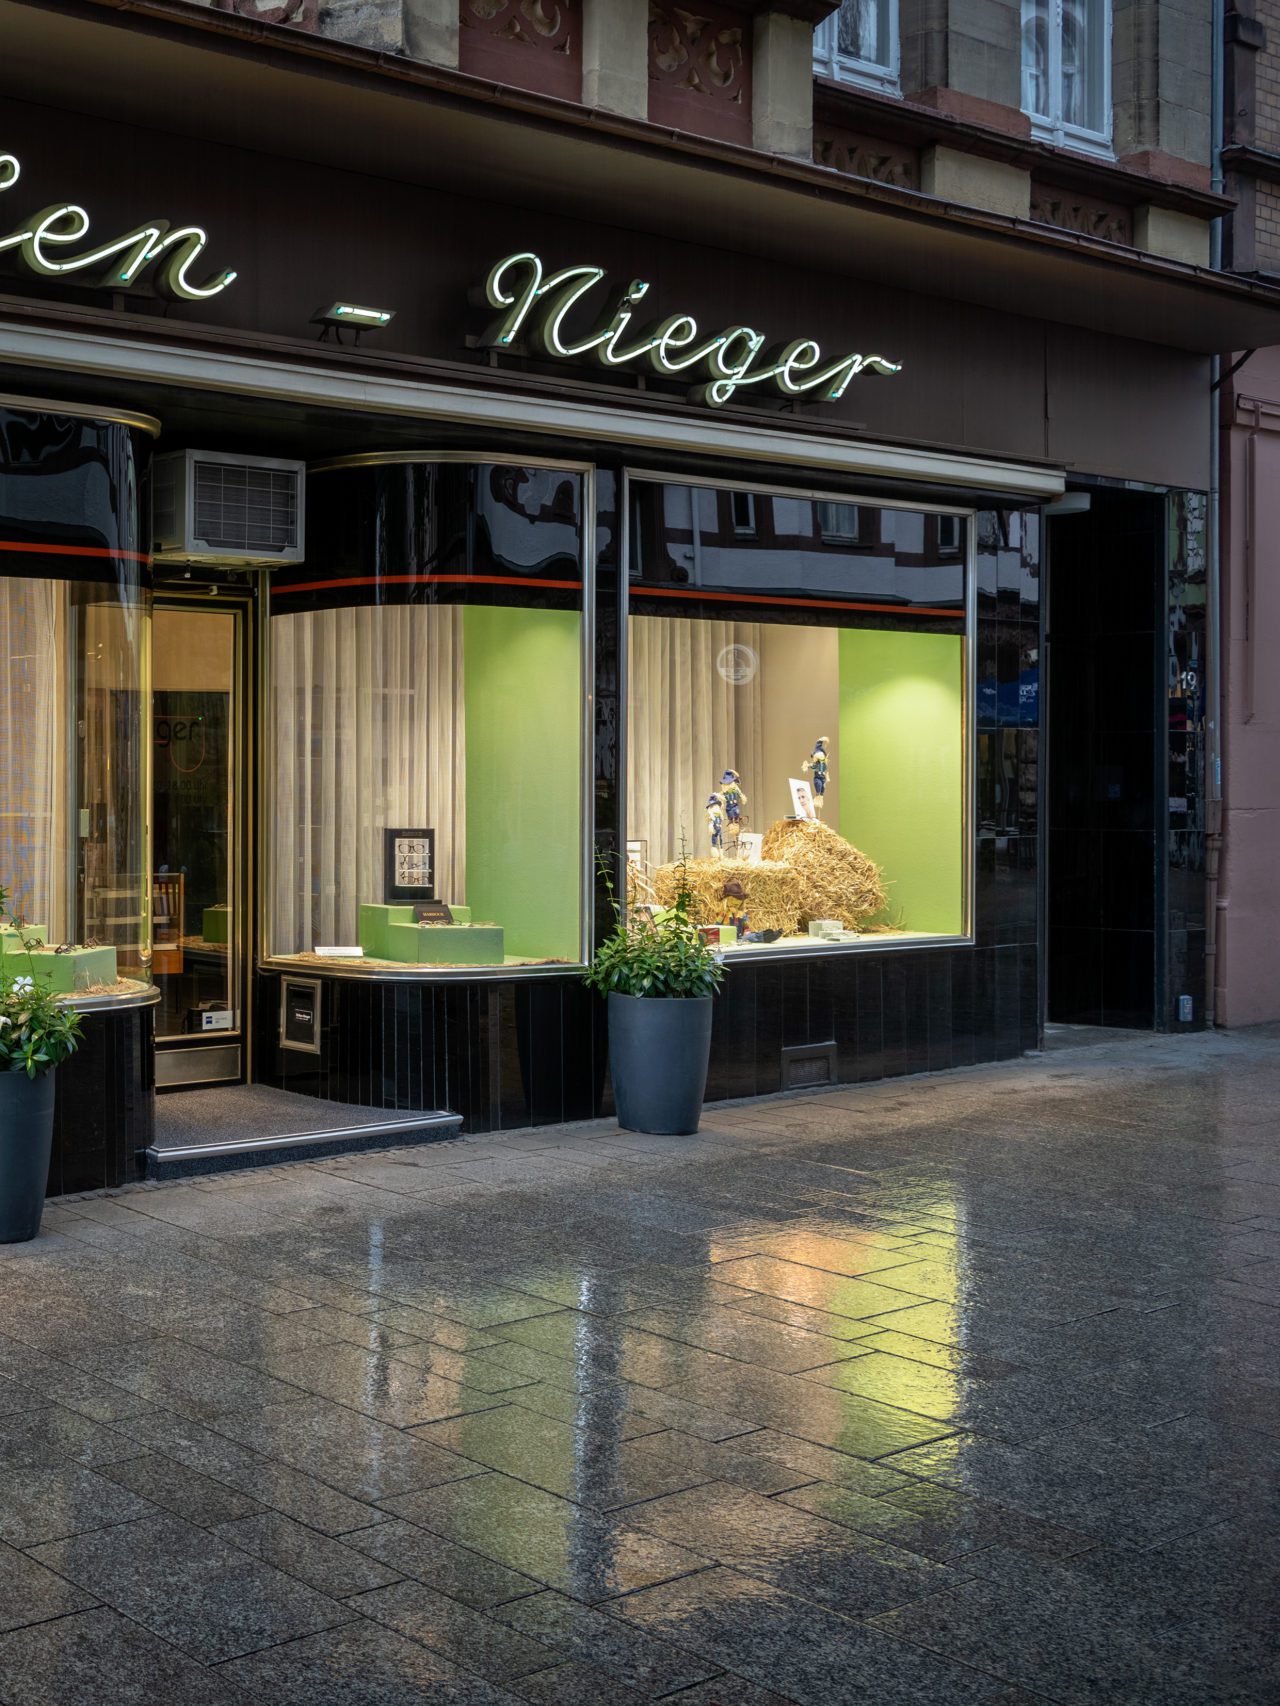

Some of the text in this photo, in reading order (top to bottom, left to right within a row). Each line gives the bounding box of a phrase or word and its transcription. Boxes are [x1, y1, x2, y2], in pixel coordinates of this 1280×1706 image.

[488, 250, 902, 405] Nieger
[1180, 671, 1197, 690] 19
[156, 720, 200, 748] ger
